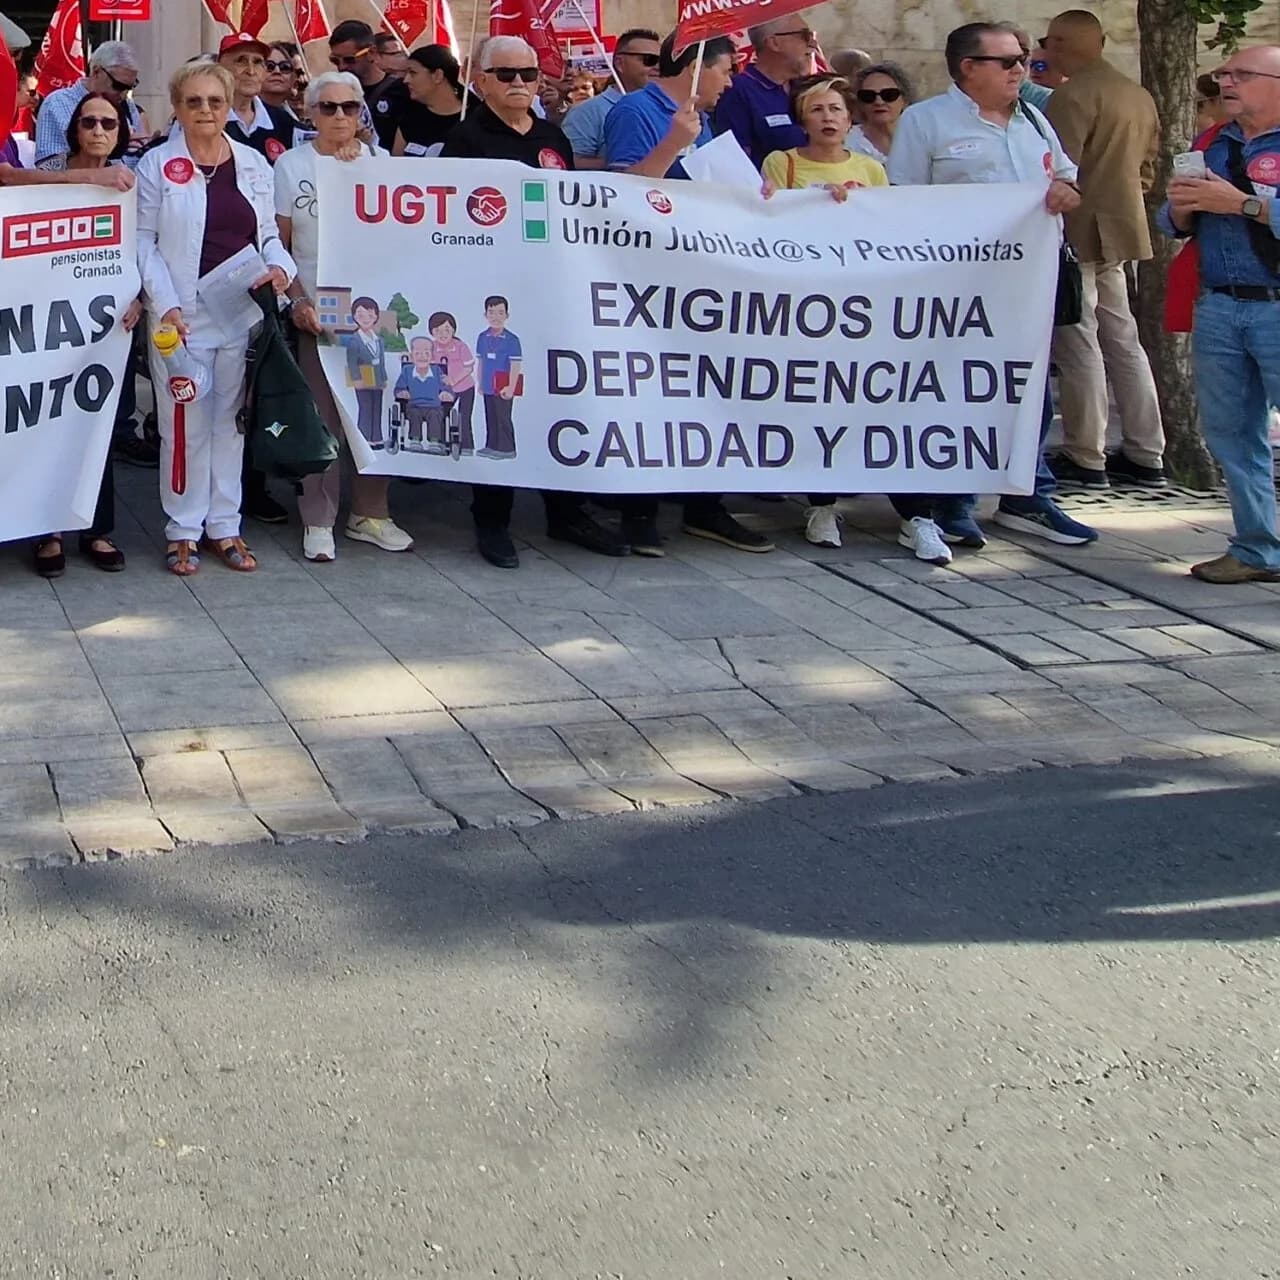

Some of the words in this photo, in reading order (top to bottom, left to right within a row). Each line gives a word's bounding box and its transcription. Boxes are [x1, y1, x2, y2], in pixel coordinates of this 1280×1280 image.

[354, 183, 458, 225] UGT
[558, 180, 618, 209] UJP
[9, 216, 93, 249] CCOO
[431, 231, 494, 247] Granada
[562, 218, 652, 249] Unión
[664, 226, 822, 263] Jubilad@s
[829, 244, 846, 267] y
[854, 237, 1024, 262] Pensionistas
[51, 249, 121, 269] pensionistas
[73, 263, 123, 279] Granada
[591, 281, 872, 340] EXIGIMOS
[893, 295, 995, 339] UNA
[546, 349, 946, 405] DEPENDENCIA
[962, 359, 1033, 405] DE
[546, 418, 795, 469] CALIDAD
[814, 425, 848, 469] Y
[864, 425, 1010, 471] DIGN
